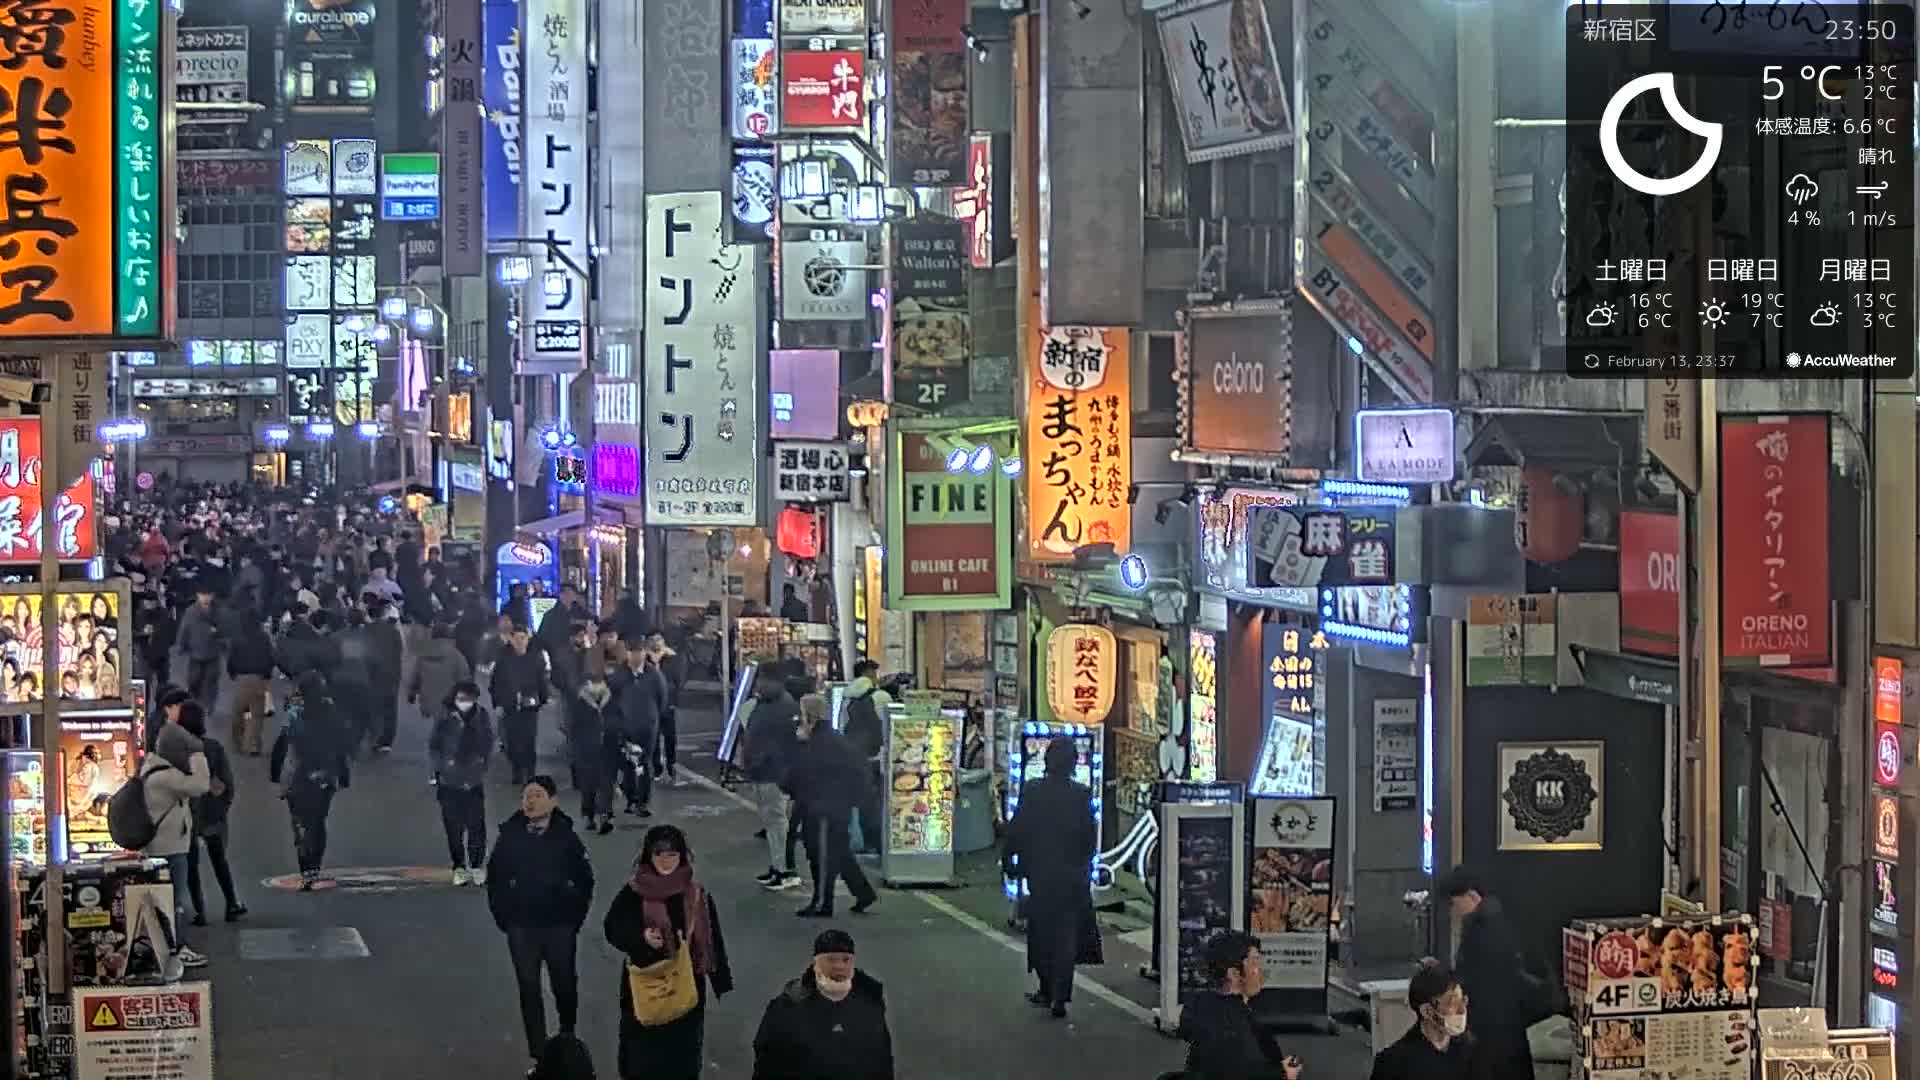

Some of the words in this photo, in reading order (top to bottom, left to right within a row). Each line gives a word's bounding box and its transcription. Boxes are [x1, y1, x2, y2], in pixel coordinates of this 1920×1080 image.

[295, 10, 369, 25] auralume
[1314, 21, 1334, 40] 5
[1315, 122, 1334, 141] 3
[386, 182, 436, 194] FamilyMart
[1314, 171, 1333, 192] 2
[902, 255, 960, 270] Walton's
[1312, 268, 1341, 297] B1
[660, 207, 693, 462] トントン
[1213, 352, 1264, 394] celona
[72, 351, 92, 443] 通り一番街
[918, 385, 947, 403] 2F
[1395, 421, 1413, 449] A
[780, 449, 844, 471] 酒場心
[1042, 394, 1087, 545] まっちゃん
[1403, 459, 1445, 469] MODE
[911, 482, 987, 513] FINE
[1347, 519, 1389, 533] フリー
[1757, 430, 1789, 604] 俺のイタリアン
[911, 558, 955, 574] ONLINE
[957, 558, 990, 573] CAFE
[1742, 614, 1808, 632] ORENO
[1741, 632, 1809, 649] ITALIAN
[1536, 780, 1564, 798] KK
[1596, 984, 1630, 1008] 4F
